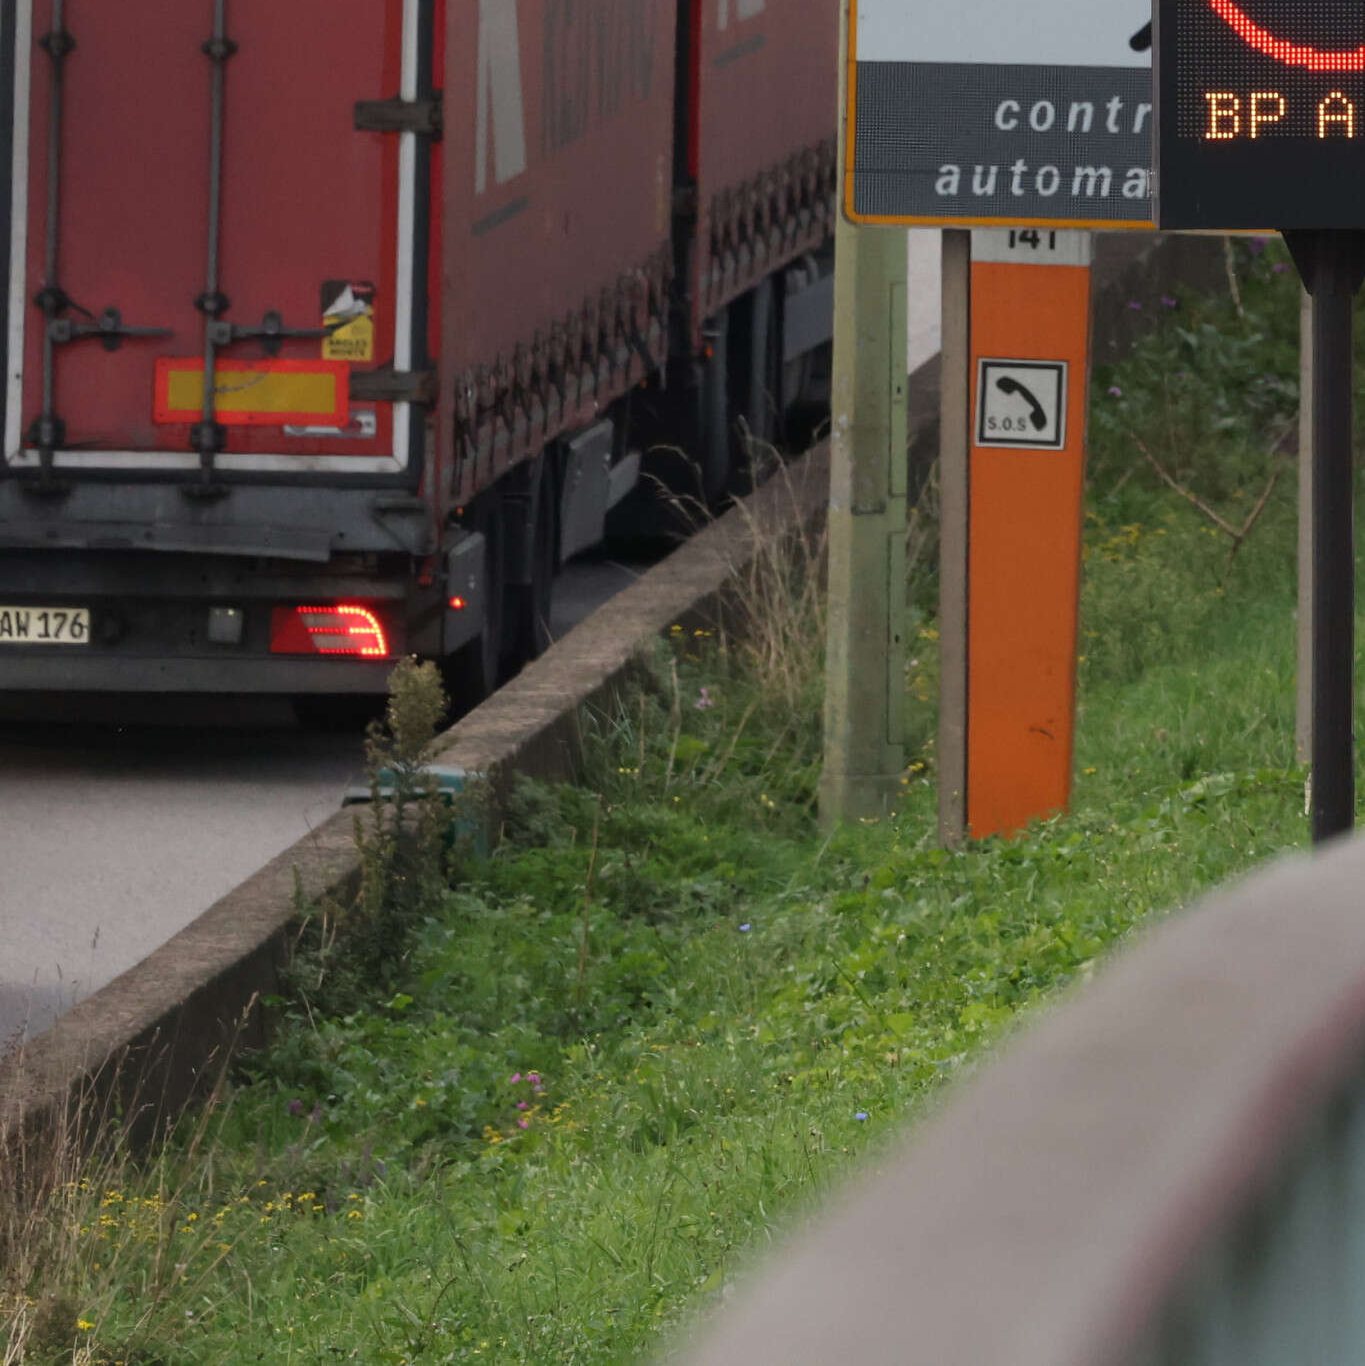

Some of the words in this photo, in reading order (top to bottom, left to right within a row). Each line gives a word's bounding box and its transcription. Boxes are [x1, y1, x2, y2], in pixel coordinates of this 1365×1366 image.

[995, 96, 1152, 133] contr
[1205, 91, 1286, 139] BP
[1318, 90, 1354, 139] A
[935, 159, 1146, 198] automa
[37, 612, 84, 639] 176
